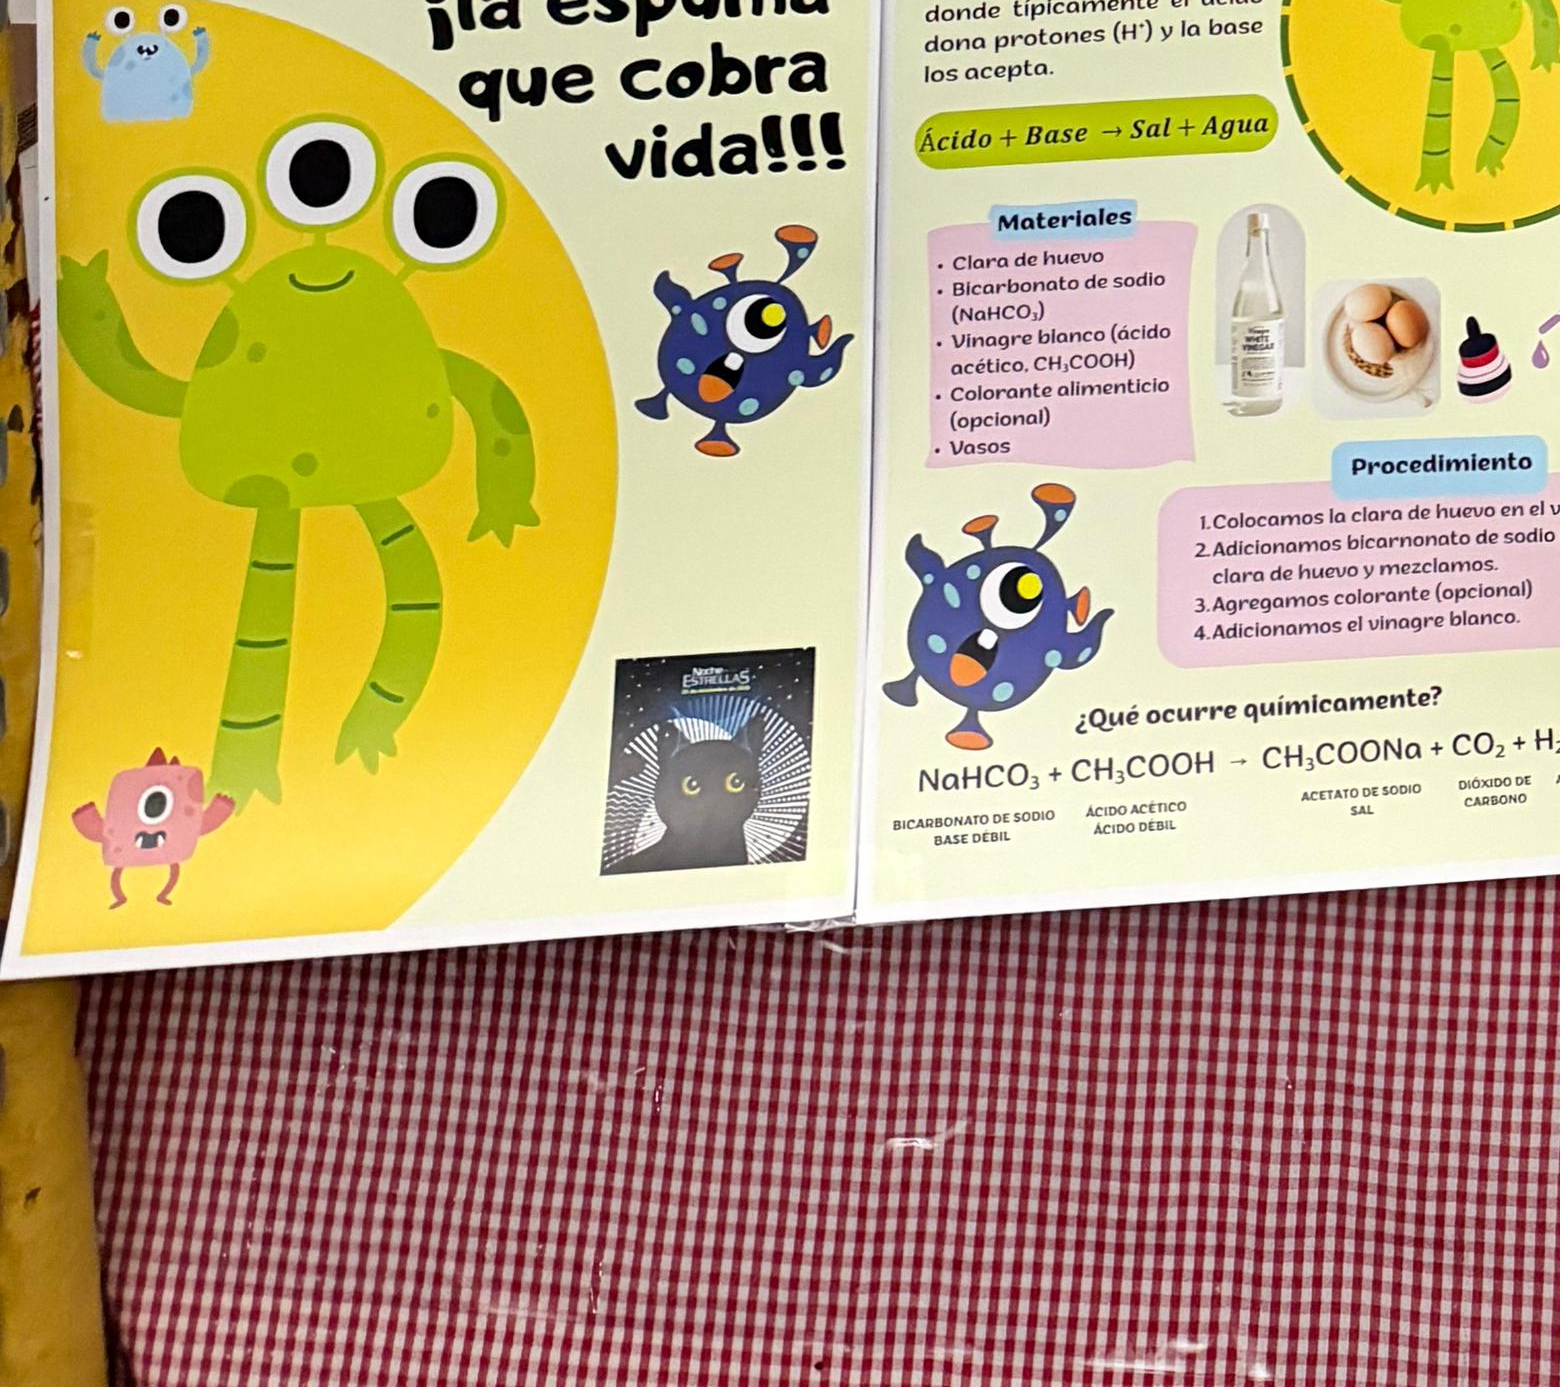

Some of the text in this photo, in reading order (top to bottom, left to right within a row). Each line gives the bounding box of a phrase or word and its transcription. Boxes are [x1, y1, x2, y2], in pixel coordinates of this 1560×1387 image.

[924, 1, 1000, 22] donde
[924, 34, 986, 52] dona
[994, 28, 1105, 53] protones
[1160, 25, 1173, 42] y
[1180, 19, 1200, 37] la
[1208, 18, 1263, 35] base
[459, 41, 827, 122] que cobra
[924, 59, 1053, 83] los acepta.
[605, 111, 845, 179] vida!!!
[917, 127, 992, 154] Ácido
[1024, 125, 1088, 145] Base
[1128, 116, 1171, 139] Sal
[1200, 115, 1269, 140] Agua
[998, 207, 1132, 231] Materiales
[952, 250, 1104, 270] Clara de huevo
[952, 271, 1165, 296] Bicarbonato de sodio
[952, 322, 1171, 350] Vinagre blanco (ácido
[950, 358, 1028, 375] acético,
[950, 377, 1169, 401] Colorante alimenticio
[949, 406, 1050, 432] (opcional)
[948, 440, 1010, 455] Vasos
[1352, 451, 1532, 475] Procedimiento
[1329, 507, 1345, 523] la
[1350, 506, 1402, 522] clara
[1407, 504, 1430, 520] de
[1435, 503, 1495, 519] huevo
[1500, 504, 1524, 517] en
[1528, 499, 1544, 516] el
[1346, 530, 1470, 550] bicarnonato
[1475, 528, 1498, 544] de
[1503, 527, 1555, 544] sodio
[1212, 557, 1498, 584] clara de huevo y mezclamos.
[1333, 586, 1430, 605] colorante
[1435, 578, 1532, 603] (opcional)
[1346, 615, 1362, 632] el
[1367, 615, 1444, 633] vinagre
[1449, 610, 1520, 626] blanco.
[1074, 685, 1442, 734] ¿Qué ocurre químicamente?
[1300, 783, 1421, 801] ACETATO DE SODIO
[1458, 775, 1531, 790] DIÓXIDO DE
[1085, 801, 1186, 817] ÁCIDO ACÉTICO
[1350, 805, 1373, 815] SAL
[1464, 793, 1527, 807] CARBONO
[892, 809, 1055, 830] BICARBONATO DE SODIO
[1093, 820, 1176, 834] ÁCIDO DÉBIL
[933, 831, 1010, 846] BASE DÉBIL
